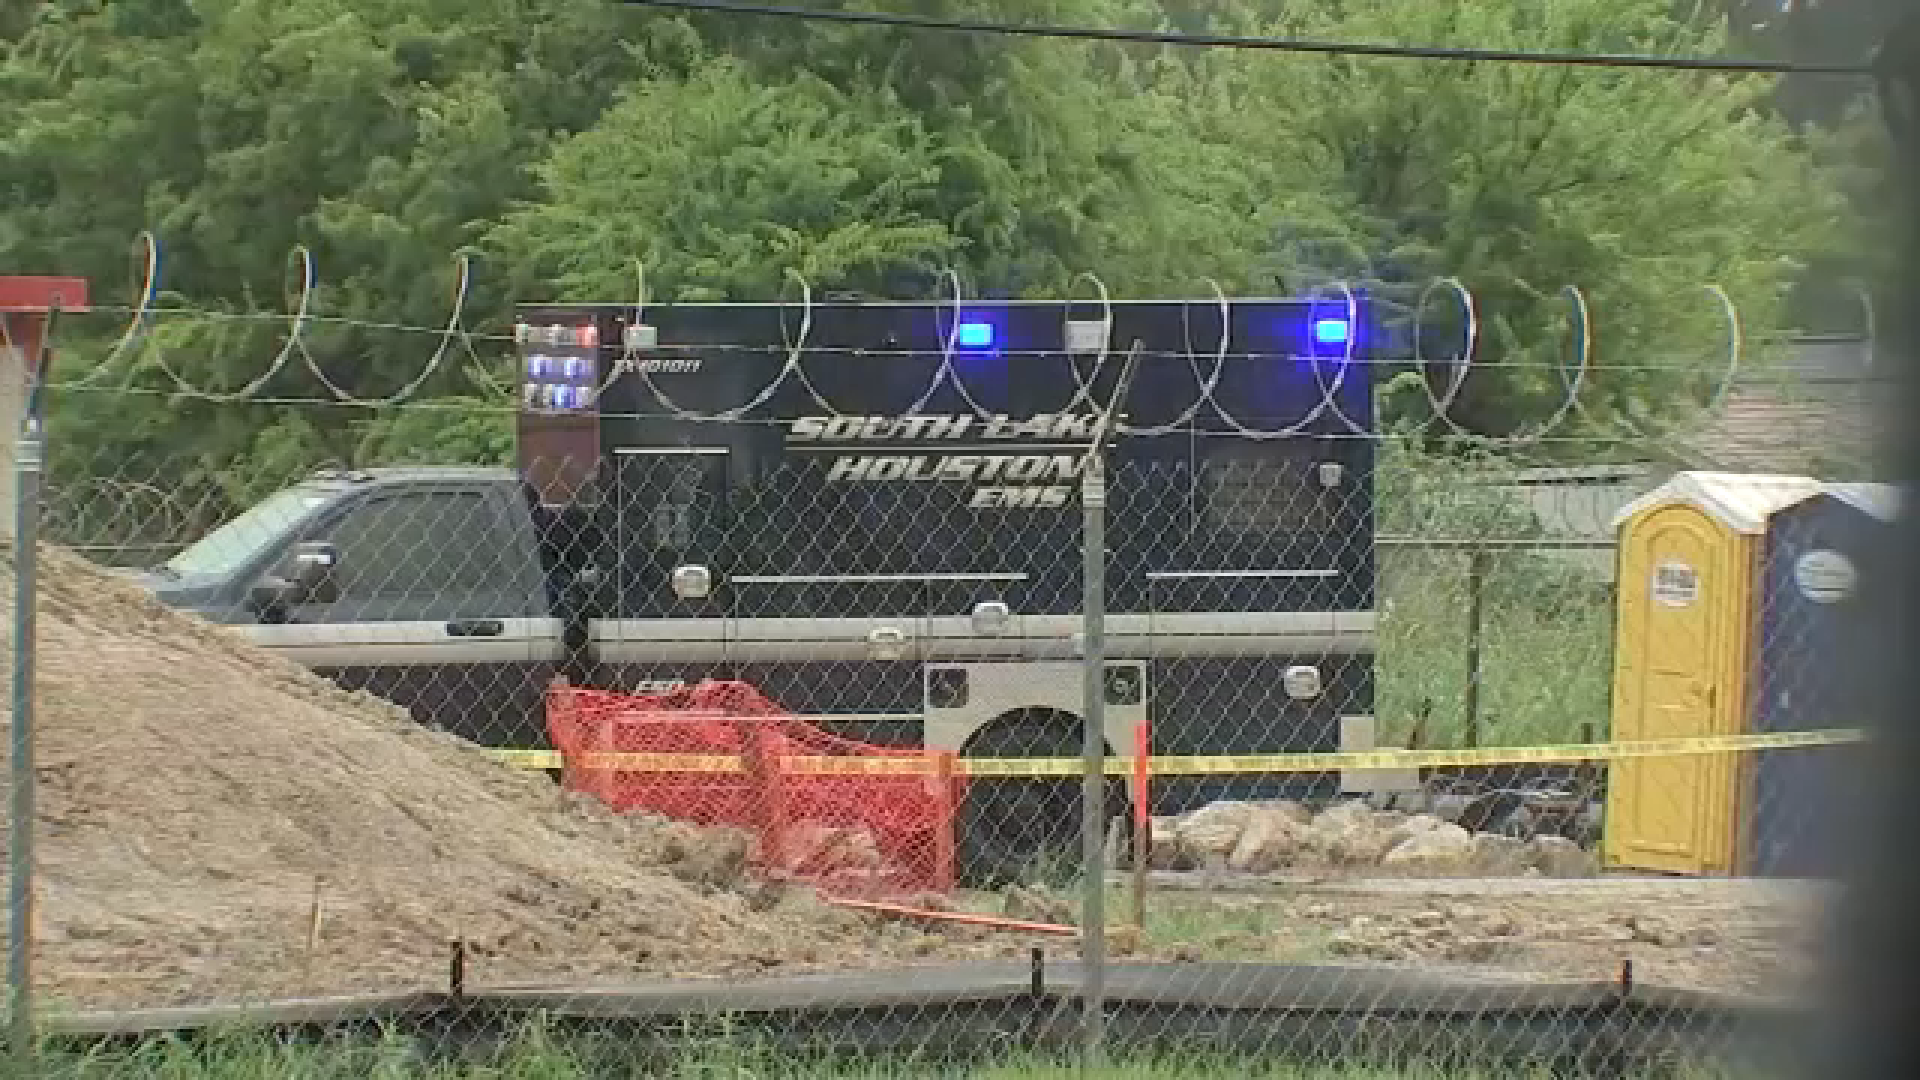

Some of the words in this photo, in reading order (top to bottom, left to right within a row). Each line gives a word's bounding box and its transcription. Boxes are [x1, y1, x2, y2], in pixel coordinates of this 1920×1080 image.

[786, 414, 973, 441] SOUTH
[827, 455, 1091, 481] HOUSTON
[968, 485, 1072, 508] EMS
